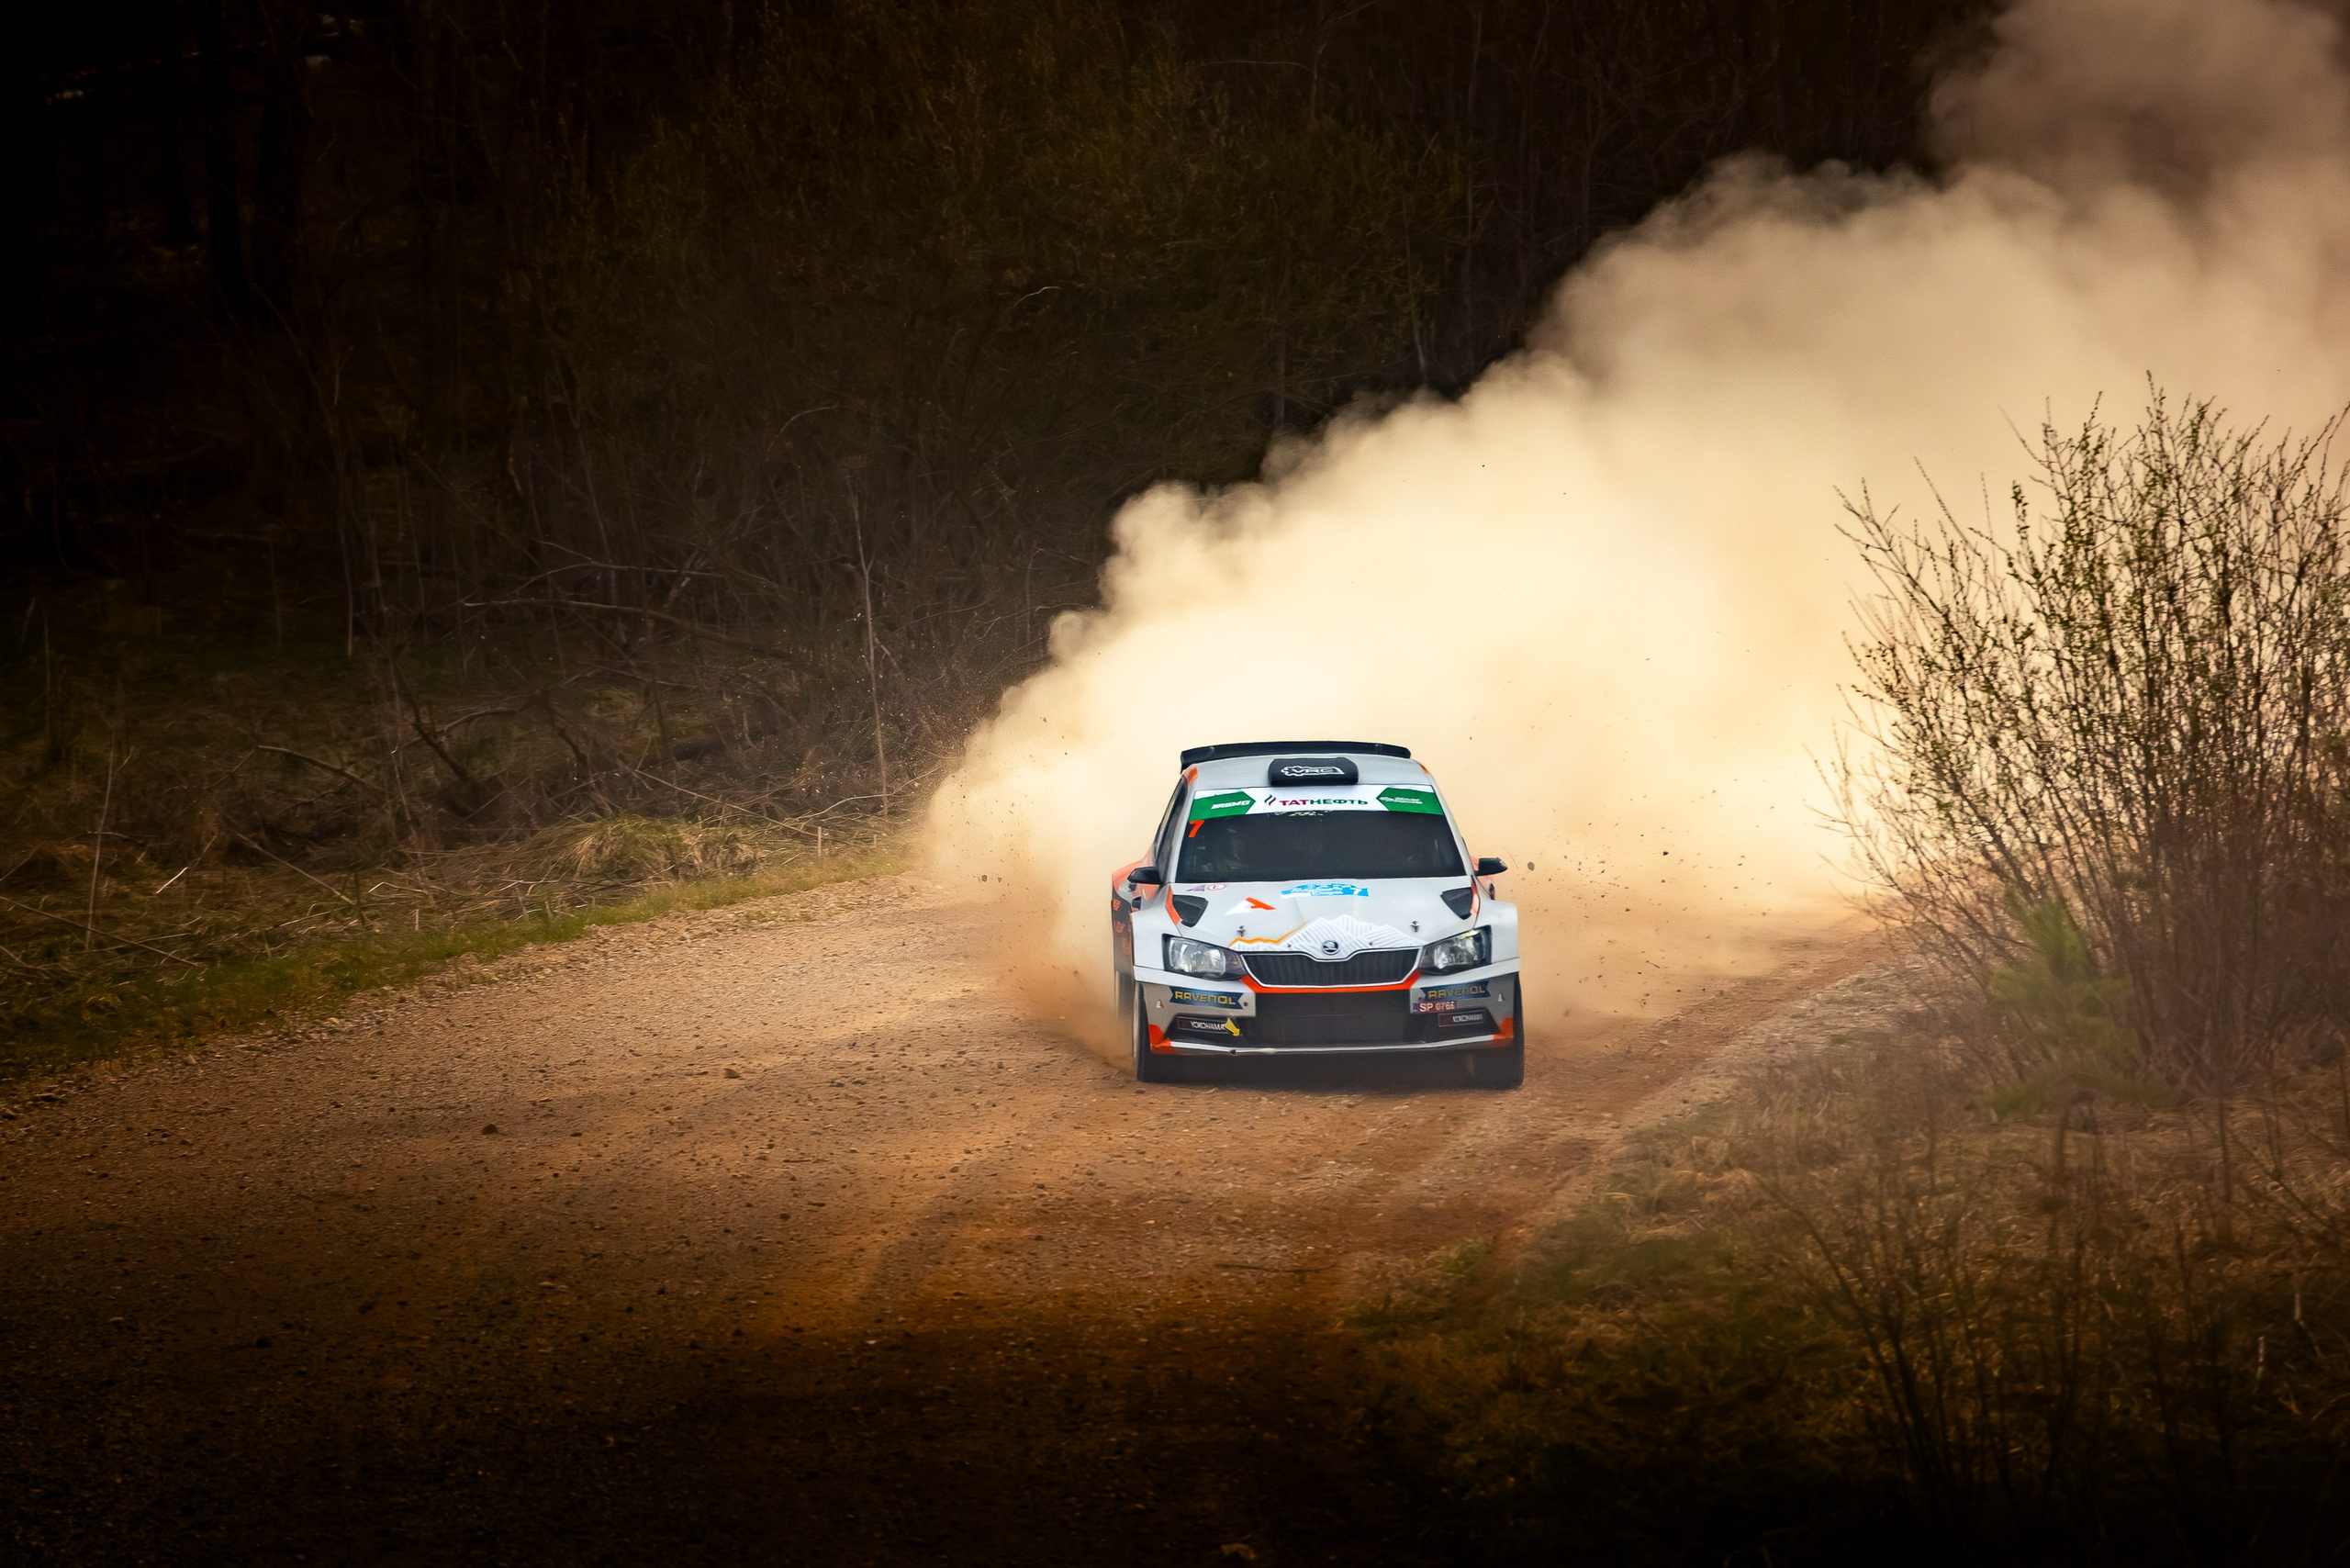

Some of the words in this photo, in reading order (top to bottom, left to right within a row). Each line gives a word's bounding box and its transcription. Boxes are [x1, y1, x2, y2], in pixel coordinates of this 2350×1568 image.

[1189, 820, 1204, 838] 7
[1175, 991, 1236, 1005] RAVENOL
[1419, 1002, 1433, 1013] SP
